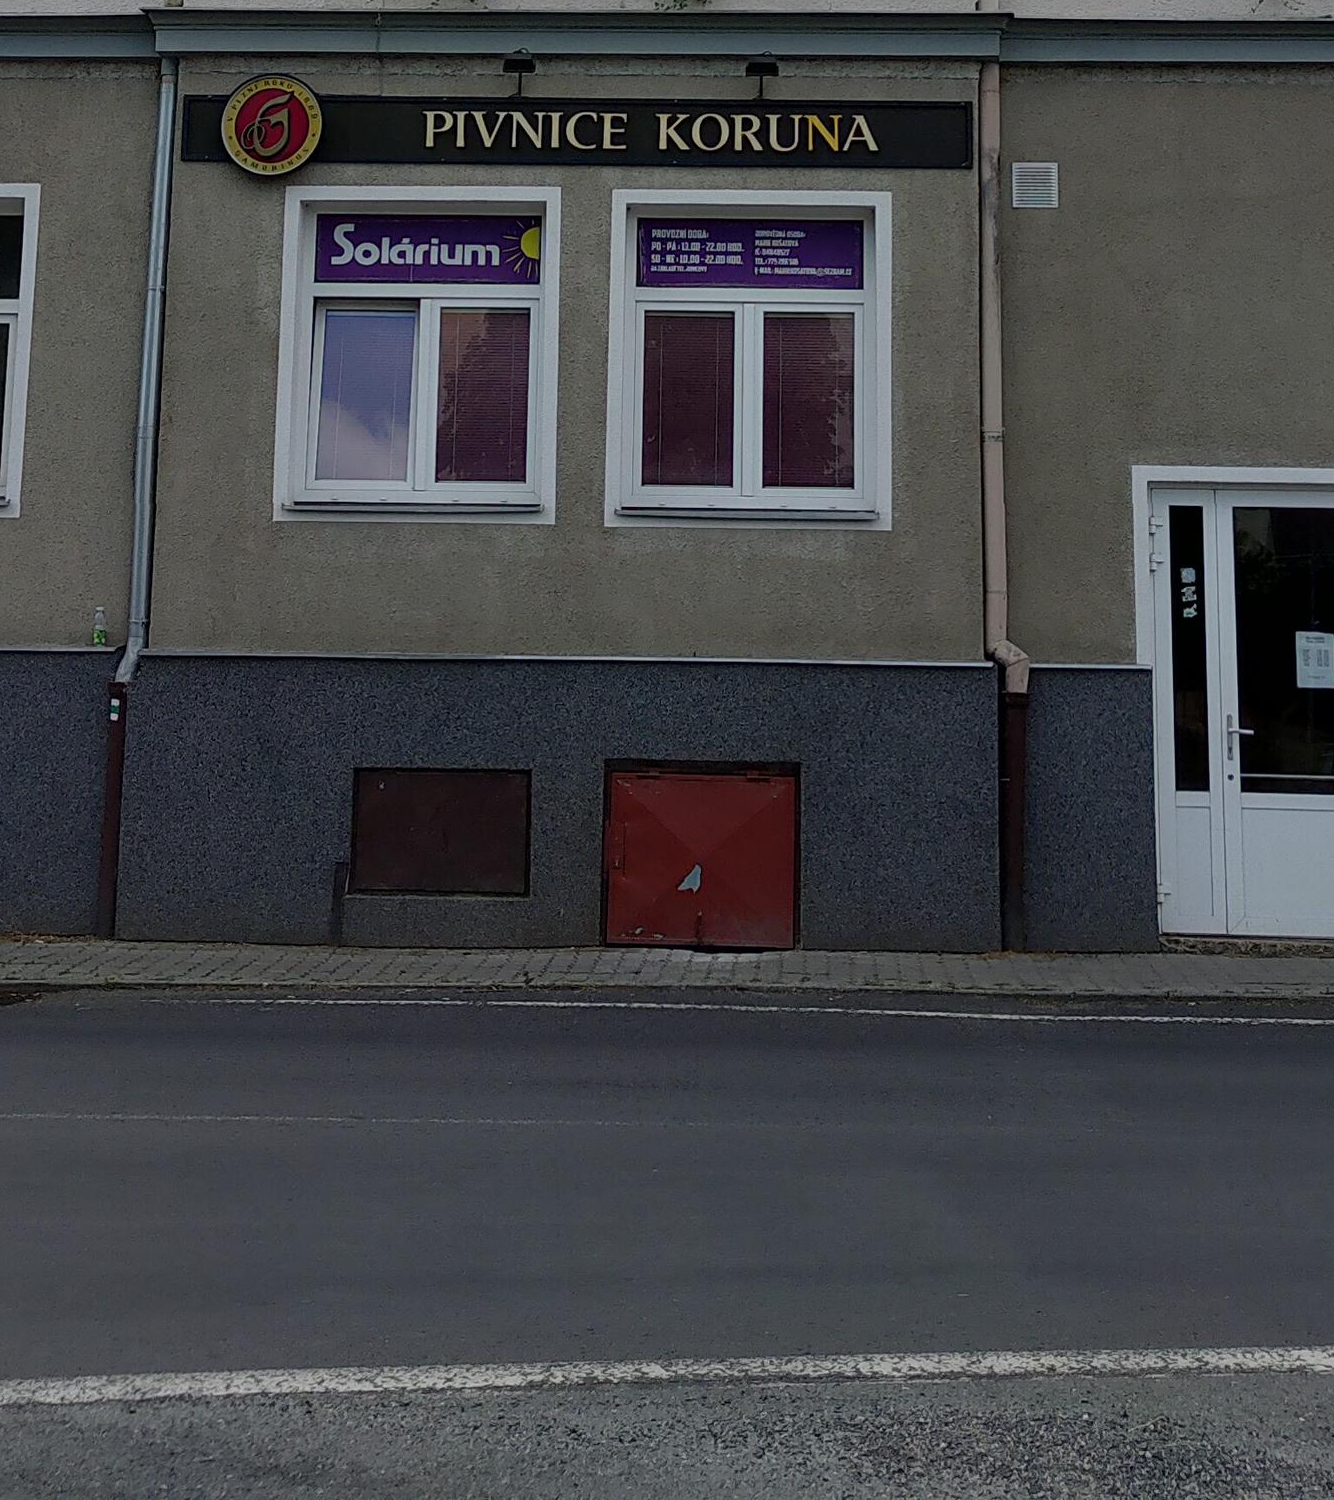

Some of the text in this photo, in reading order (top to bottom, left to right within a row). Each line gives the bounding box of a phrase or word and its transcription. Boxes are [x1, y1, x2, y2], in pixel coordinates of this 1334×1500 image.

[422, 110, 879, 152] PIVNICE KORUNA
[331, 223, 500, 266] Solárium
